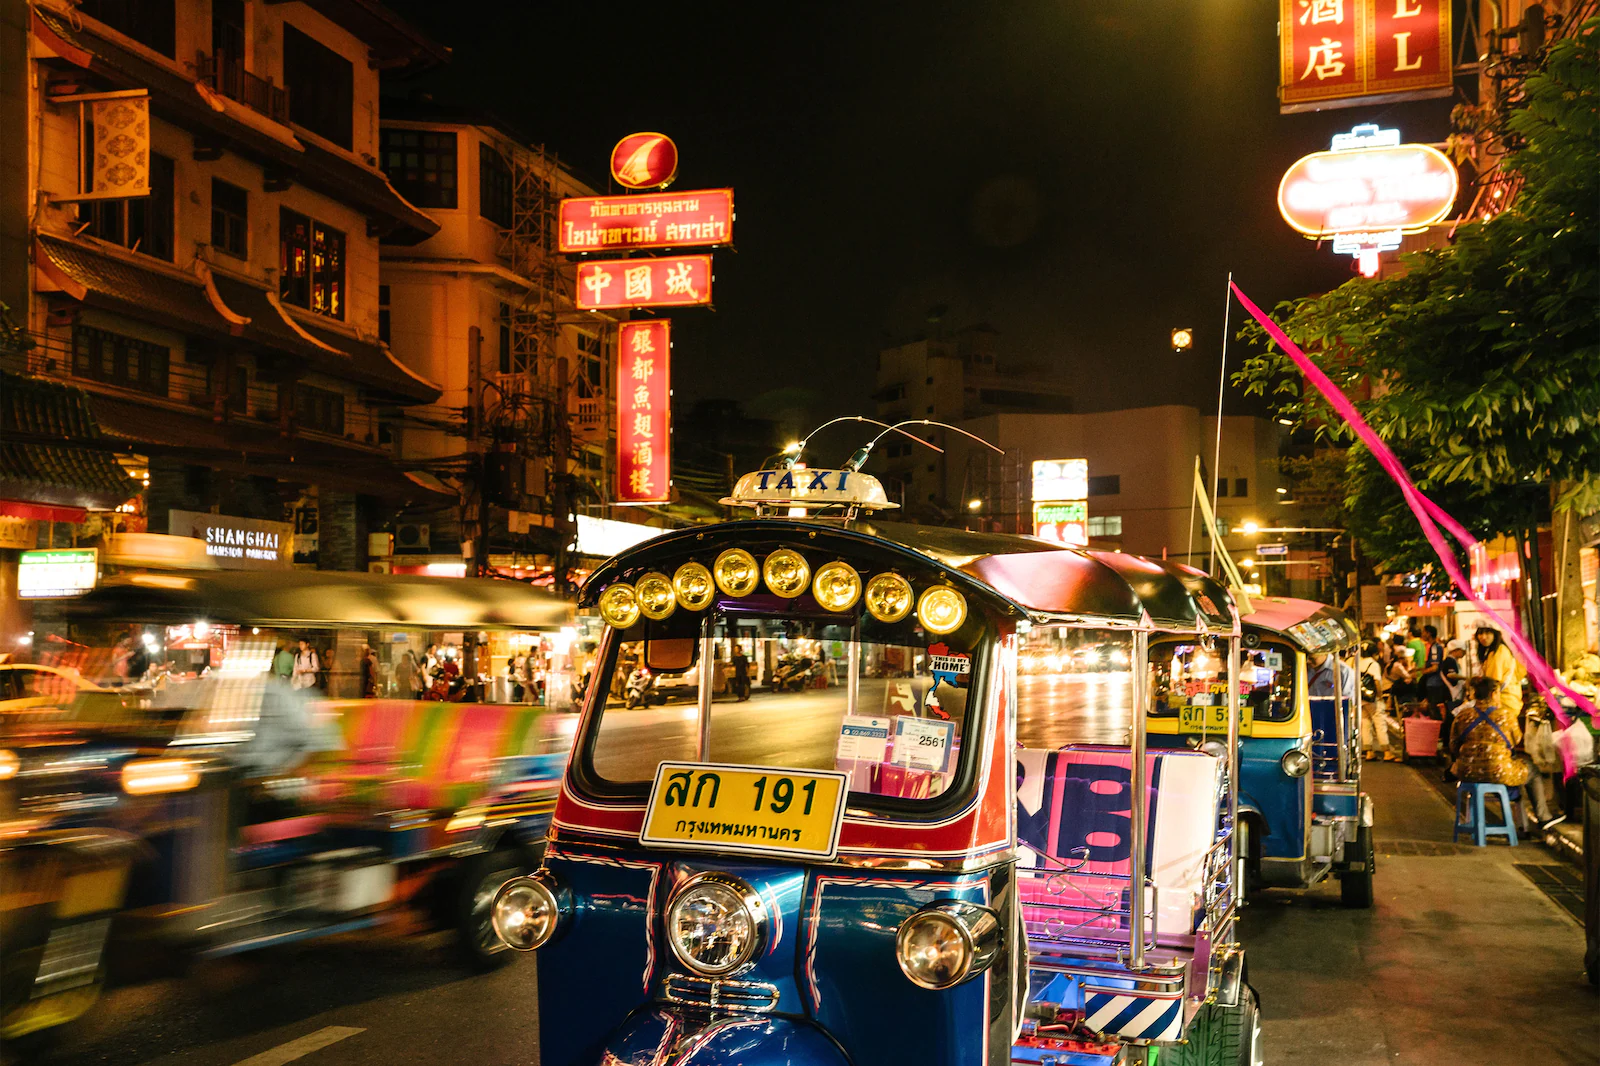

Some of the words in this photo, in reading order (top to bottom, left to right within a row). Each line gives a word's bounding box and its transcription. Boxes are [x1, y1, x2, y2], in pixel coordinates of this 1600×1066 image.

[1298, 0, 1346, 81] 酒店
[564, 219, 658, 246] ไชน่าทาวน์
[665, 215, 725, 241] สกาล่า
[584, 262, 699, 304] 中國城
[629, 329, 656, 496] 銀都魚翅酒樓
[756, 471, 850, 491] TAXI
[206, 526, 279, 549] SHANGHAI
[206, 545, 243, 558] MANSION
[919, 735, 945, 748] 2561
[664, 770, 721, 808] สก
[753, 776, 817, 815] 191
[675, 819, 802, 842] กรุงเทพมหานคร
